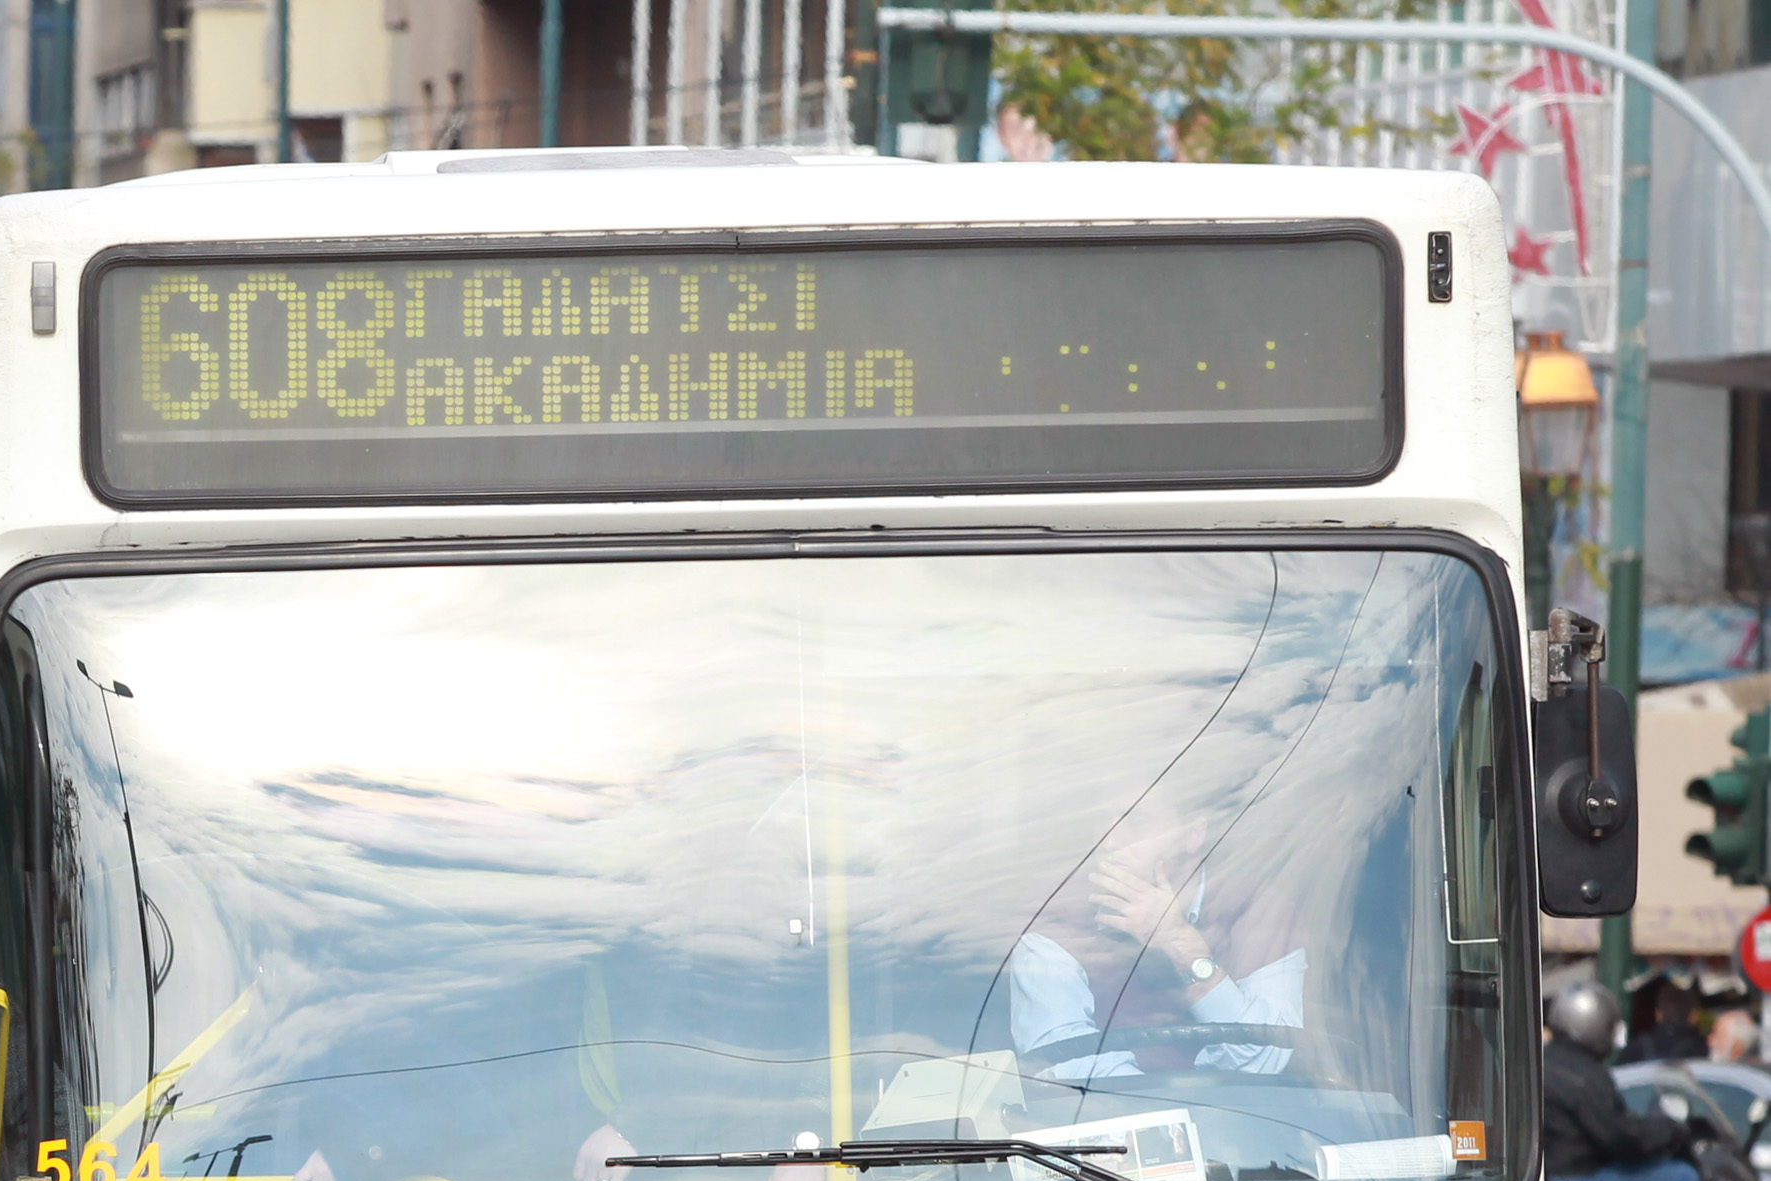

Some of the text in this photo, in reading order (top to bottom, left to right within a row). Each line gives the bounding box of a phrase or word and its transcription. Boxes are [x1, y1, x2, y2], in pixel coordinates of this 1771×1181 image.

[139, 270, 396, 421] 608
[405, 349, 914, 426] ΑΚΑΔΗΜΙΑ
[1456, 1136, 1477, 1149] 2011
